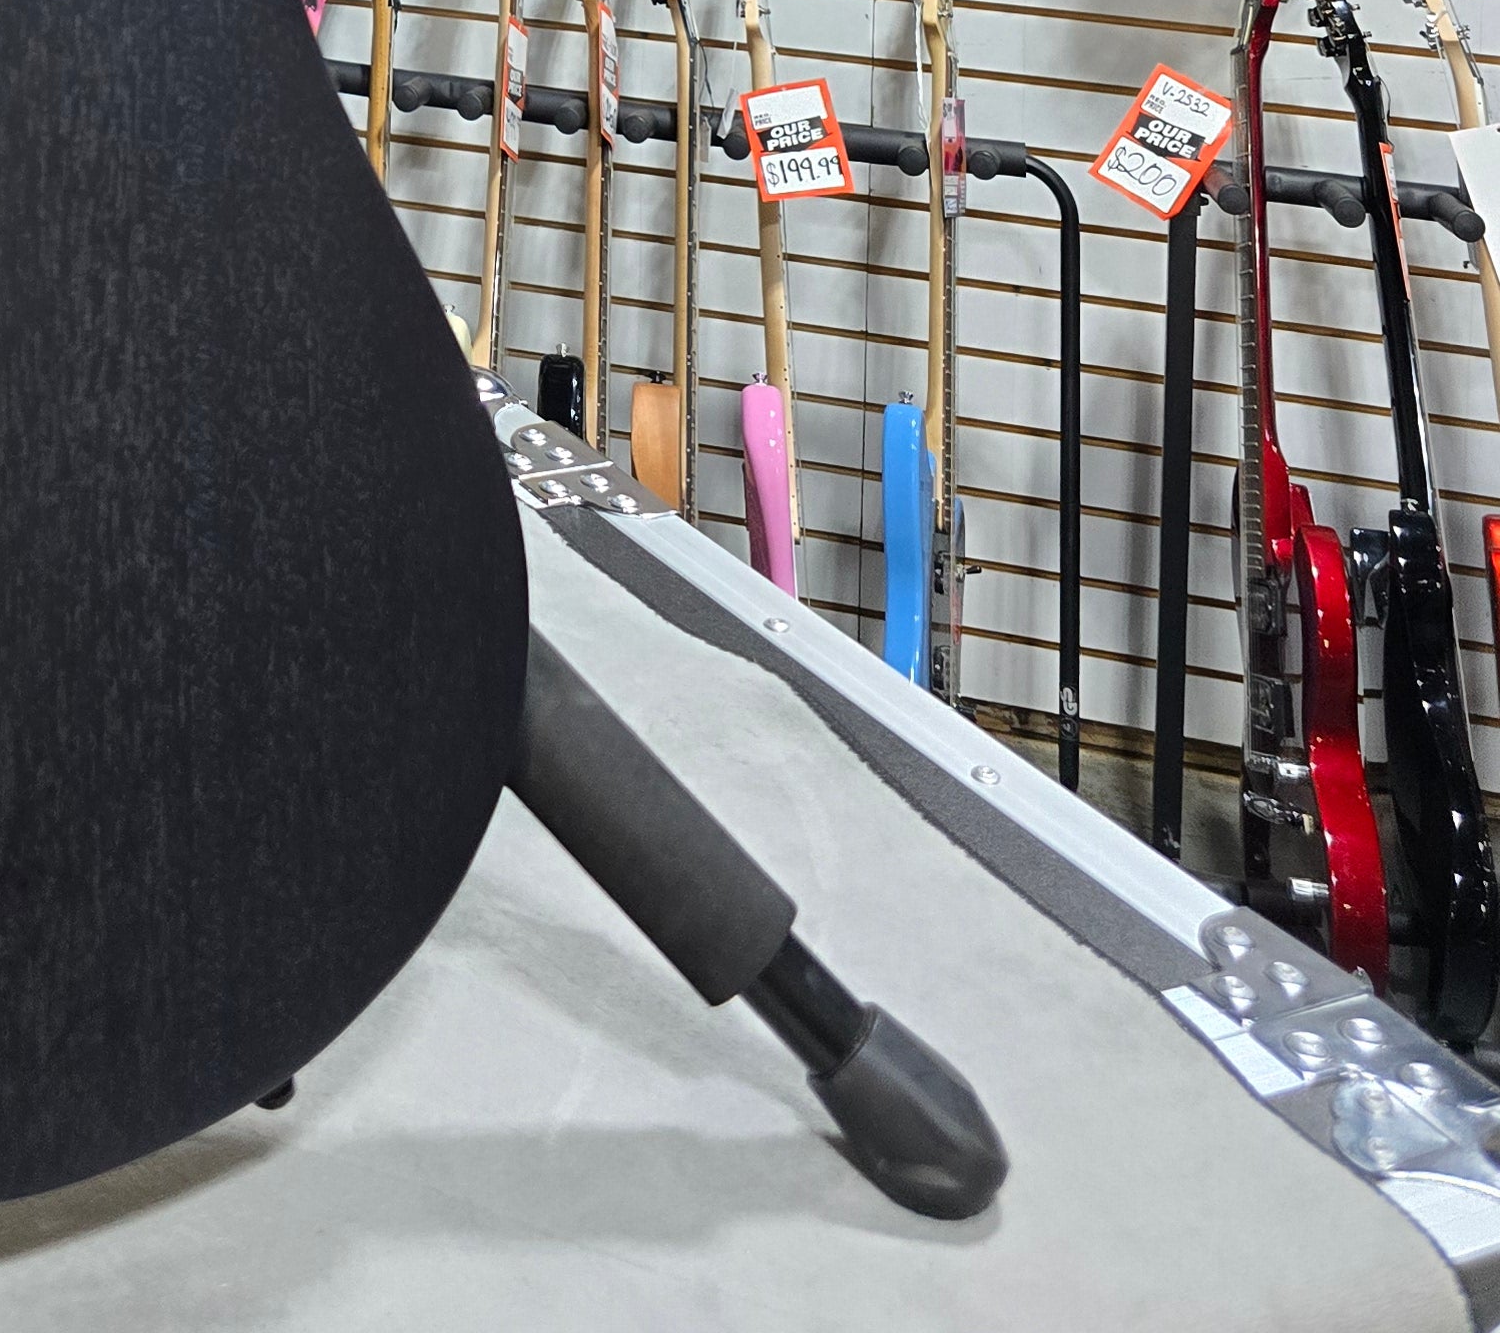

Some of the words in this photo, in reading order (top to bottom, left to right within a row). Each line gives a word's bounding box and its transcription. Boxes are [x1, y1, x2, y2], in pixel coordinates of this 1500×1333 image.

[766, 127, 824, 152] PRICE
[770, 119, 811, 139] OUR
[1133, 126, 1198, 159] PRICE
[1148, 119, 1192, 144] OUR
[765, 155, 843, 187] $199.99
[1107, 144, 1177, 196] $200
